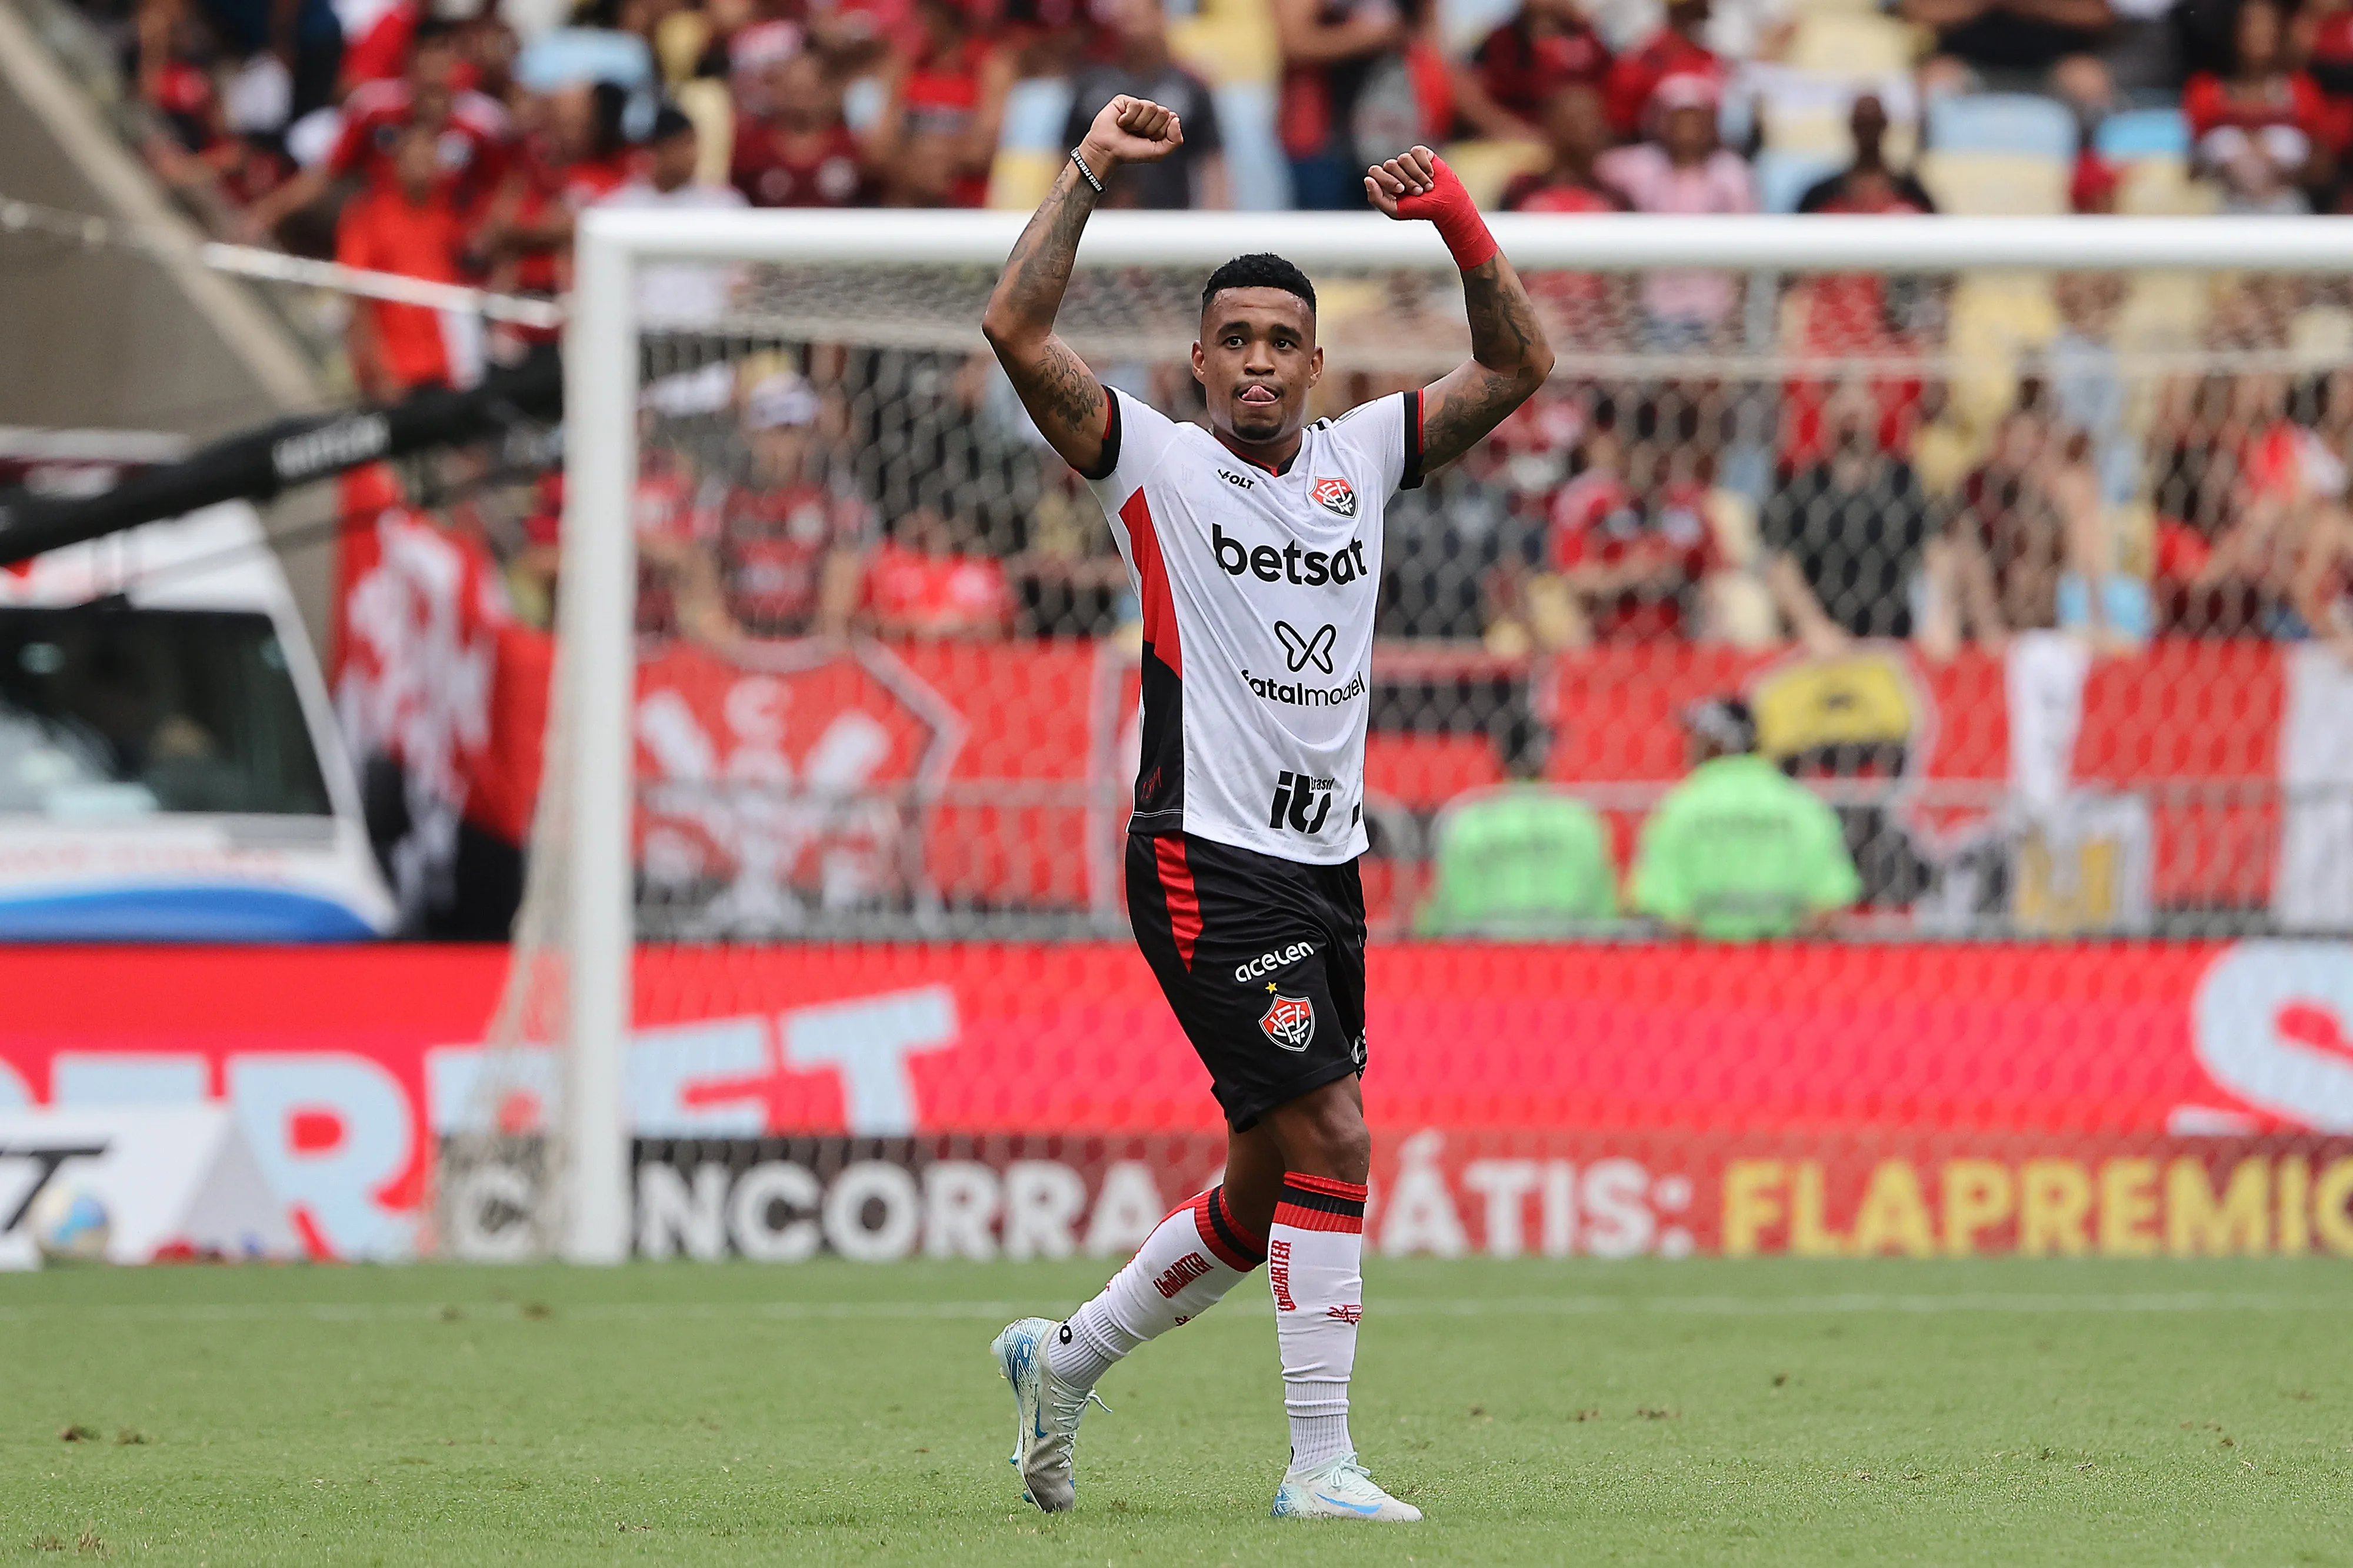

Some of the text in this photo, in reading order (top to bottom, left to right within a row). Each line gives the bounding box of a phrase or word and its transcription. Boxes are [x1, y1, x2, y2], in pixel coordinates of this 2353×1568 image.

[1212, 523, 1368, 586] betsat
[1235, 942, 1314, 982] acelen
[454, 1159, 1165, 1262] CNCORRA
[1203, 1128, 1694, 1260] ÁTIS:
